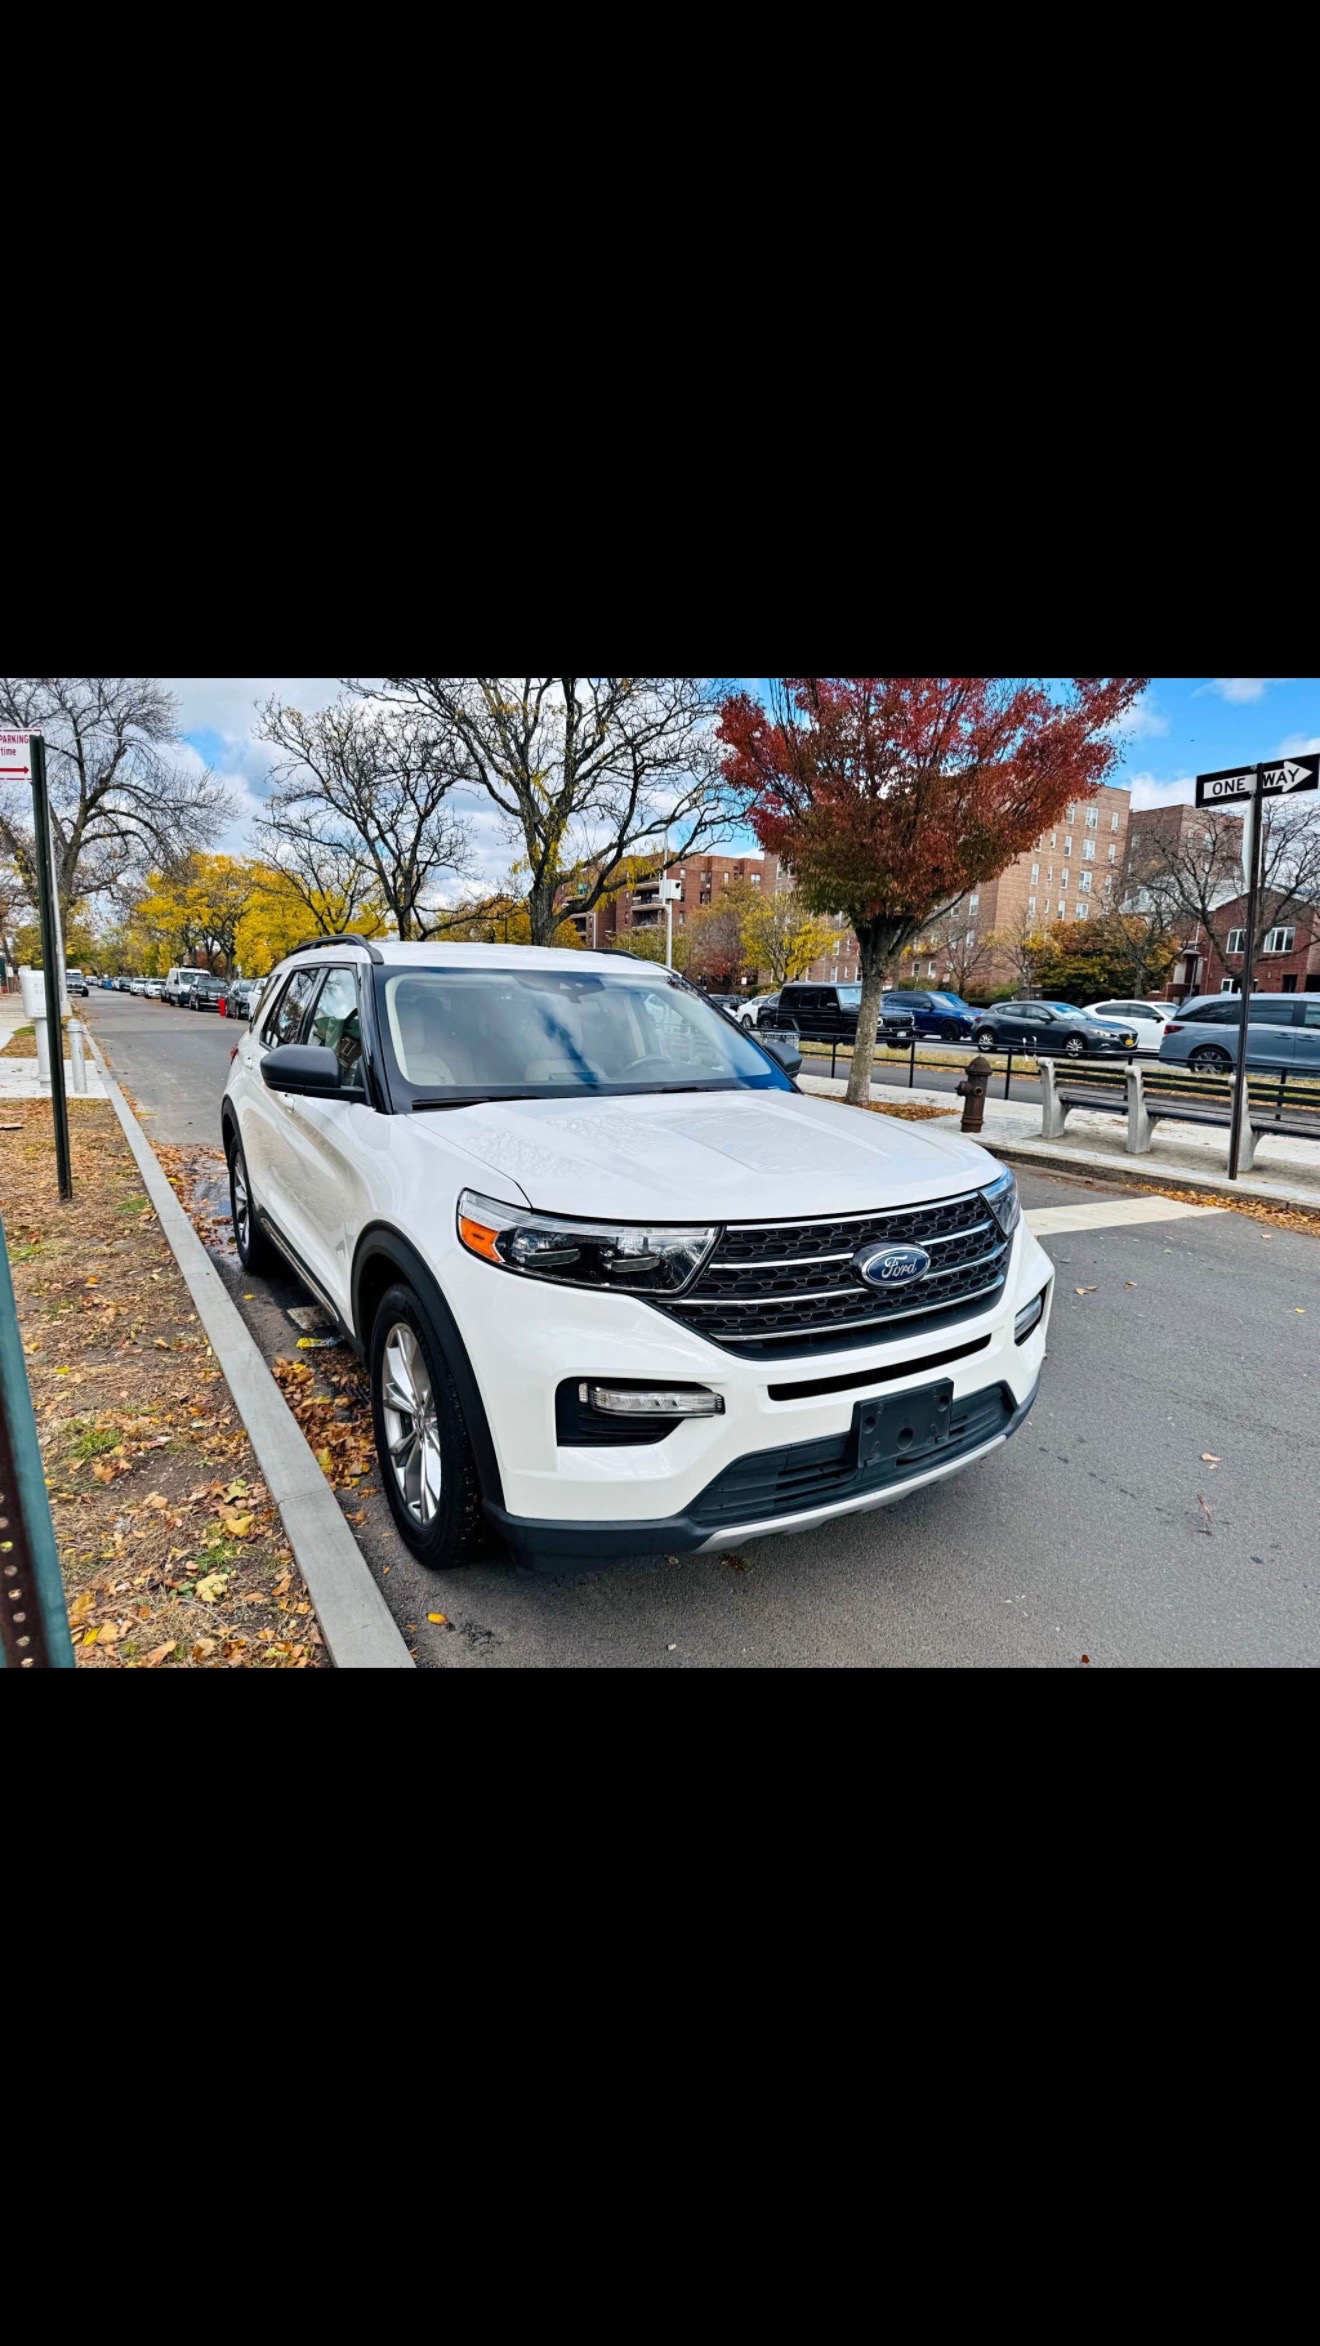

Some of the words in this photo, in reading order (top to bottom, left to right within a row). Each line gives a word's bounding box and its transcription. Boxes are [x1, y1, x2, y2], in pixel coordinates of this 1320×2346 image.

[1212, 777, 1246, 796] ONE
[1263, 768, 1300, 787] WAY
[881, 1255, 917, 1278] Ford
